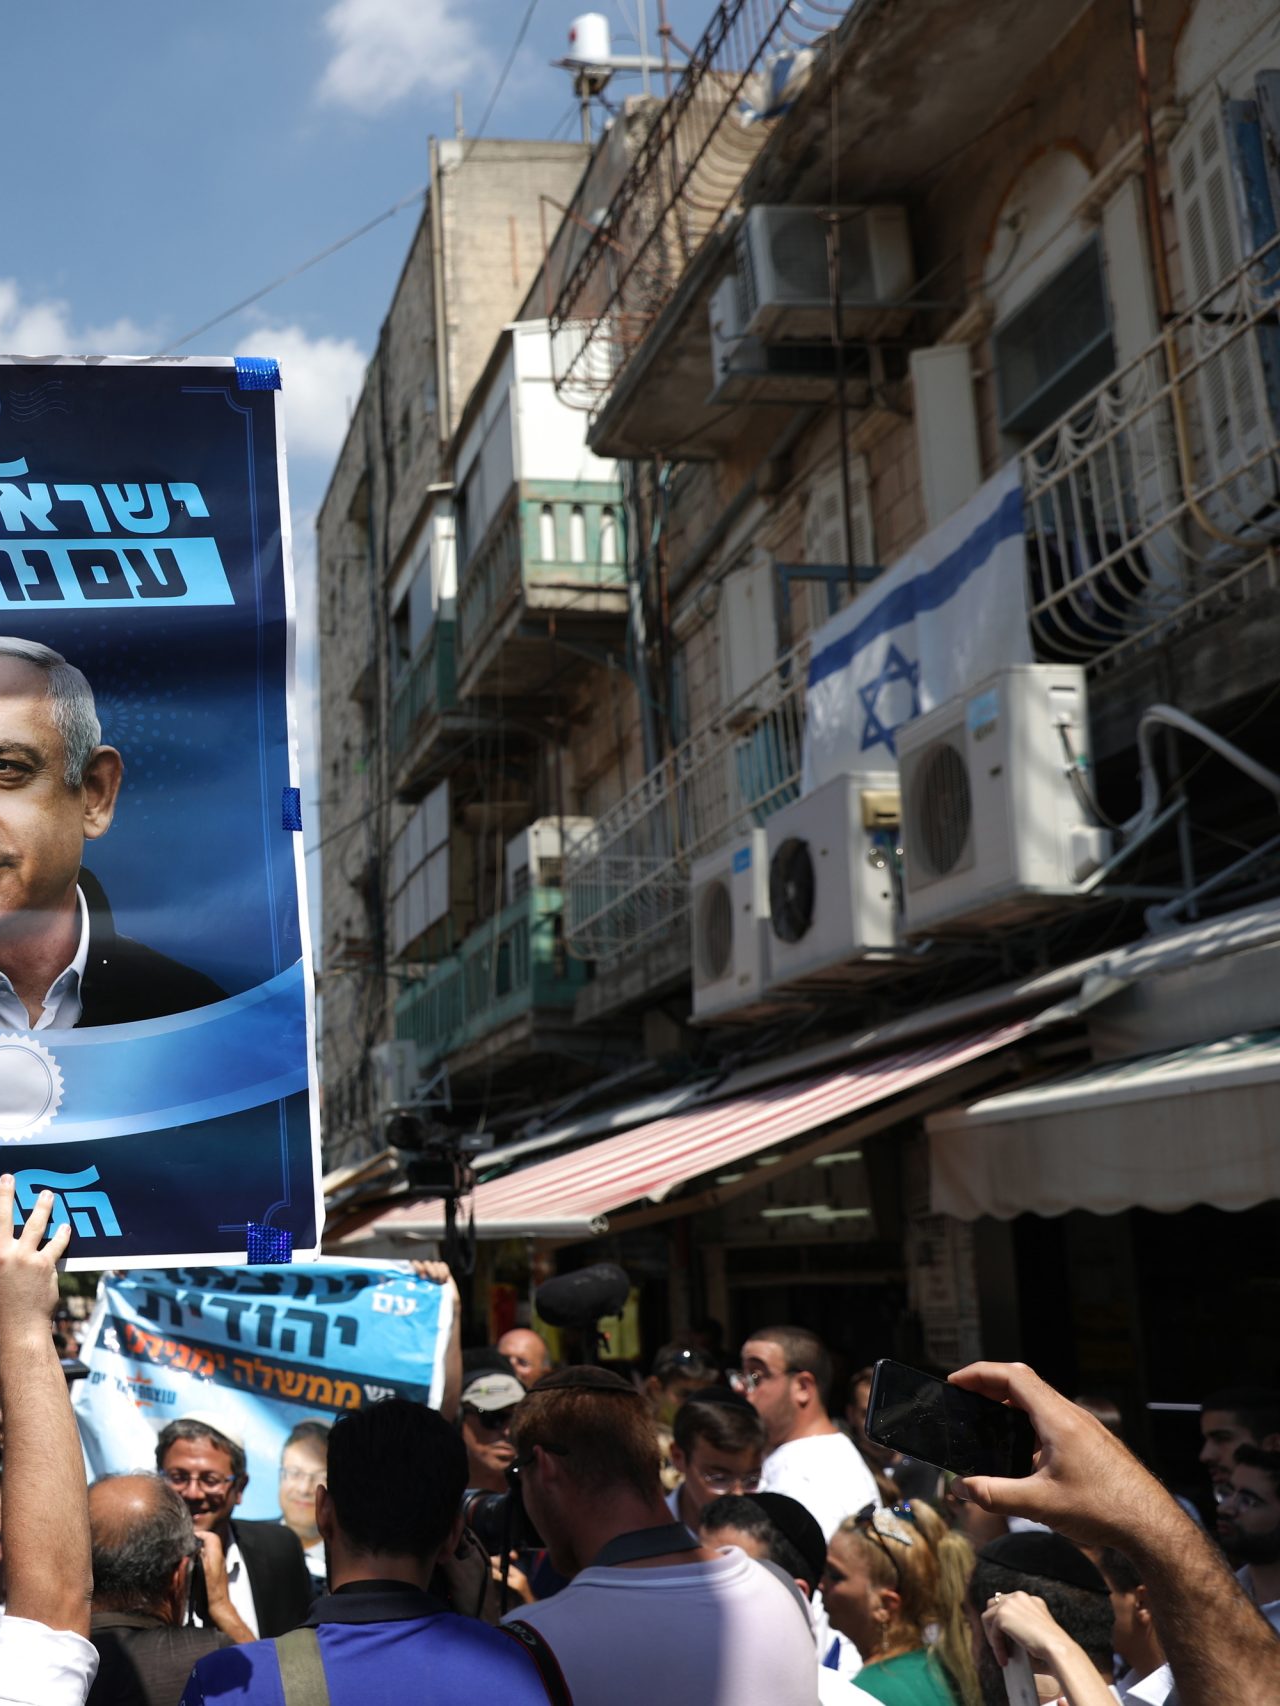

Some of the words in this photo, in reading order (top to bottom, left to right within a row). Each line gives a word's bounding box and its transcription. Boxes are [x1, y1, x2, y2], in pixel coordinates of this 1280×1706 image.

[67, 549, 188, 600] עם
[136, 1289, 359, 1359] יהודית
[232, 1358, 362, 1410] ממשלה
